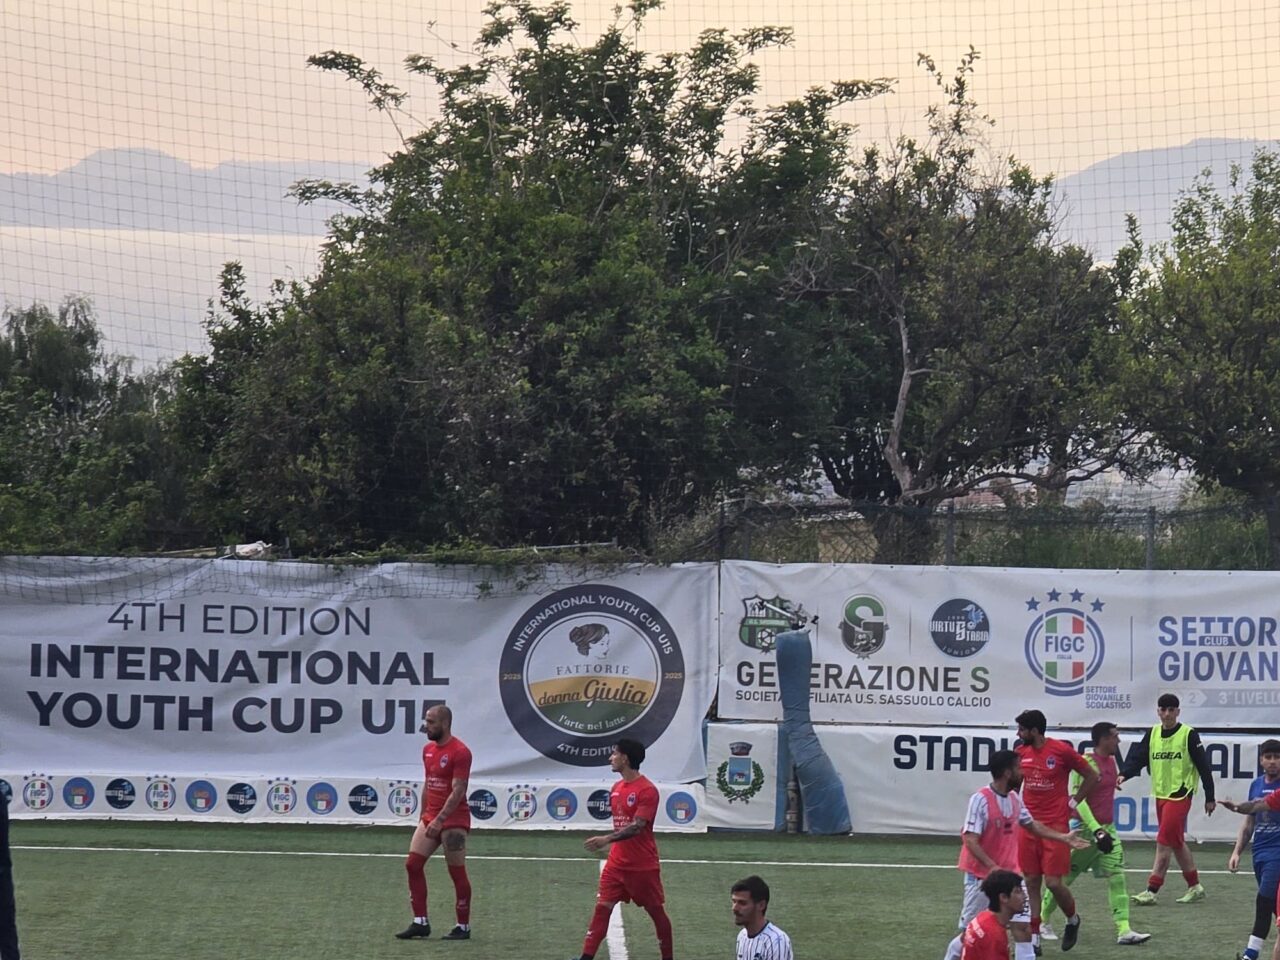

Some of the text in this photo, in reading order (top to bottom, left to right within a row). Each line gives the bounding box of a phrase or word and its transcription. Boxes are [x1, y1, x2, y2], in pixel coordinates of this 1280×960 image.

[107, 601, 371, 636] 4TH EDITION
[512, 594, 674, 655] INTERNATIONAL YOUTH CUP U15
[1045, 635, 1085, 653] FIGC
[1204, 635, 1229, 646] CLUB
[29, 642, 451, 687] INTERNATIONAL
[556, 663, 630, 676] FATTORIE
[736, 661, 990, 693] GEERAZIONE S
[538, 679, 648, 707] donna Giulia
[1085, 685, 1117, 694] SETTORE
[855, 693, 877, 705] U.S.
[879, 694, 944, 707] SASSUOLO
[946, 696, 992, 708] CALCIO
[1085, 693, 1124, 702] GIOVANILE
[26, 690, 214, 732] YOUTH
[231, 696, 344, 734] CUP
[1085, 701, 1132, 710] SCOLASTICO
[605, 714, 626, 729] latte
[557, 743, 617, 758] 4TH EDITI
[893, 735, 1022, 772] STADI
[1152, 751, 1183, 760] LEGEA
